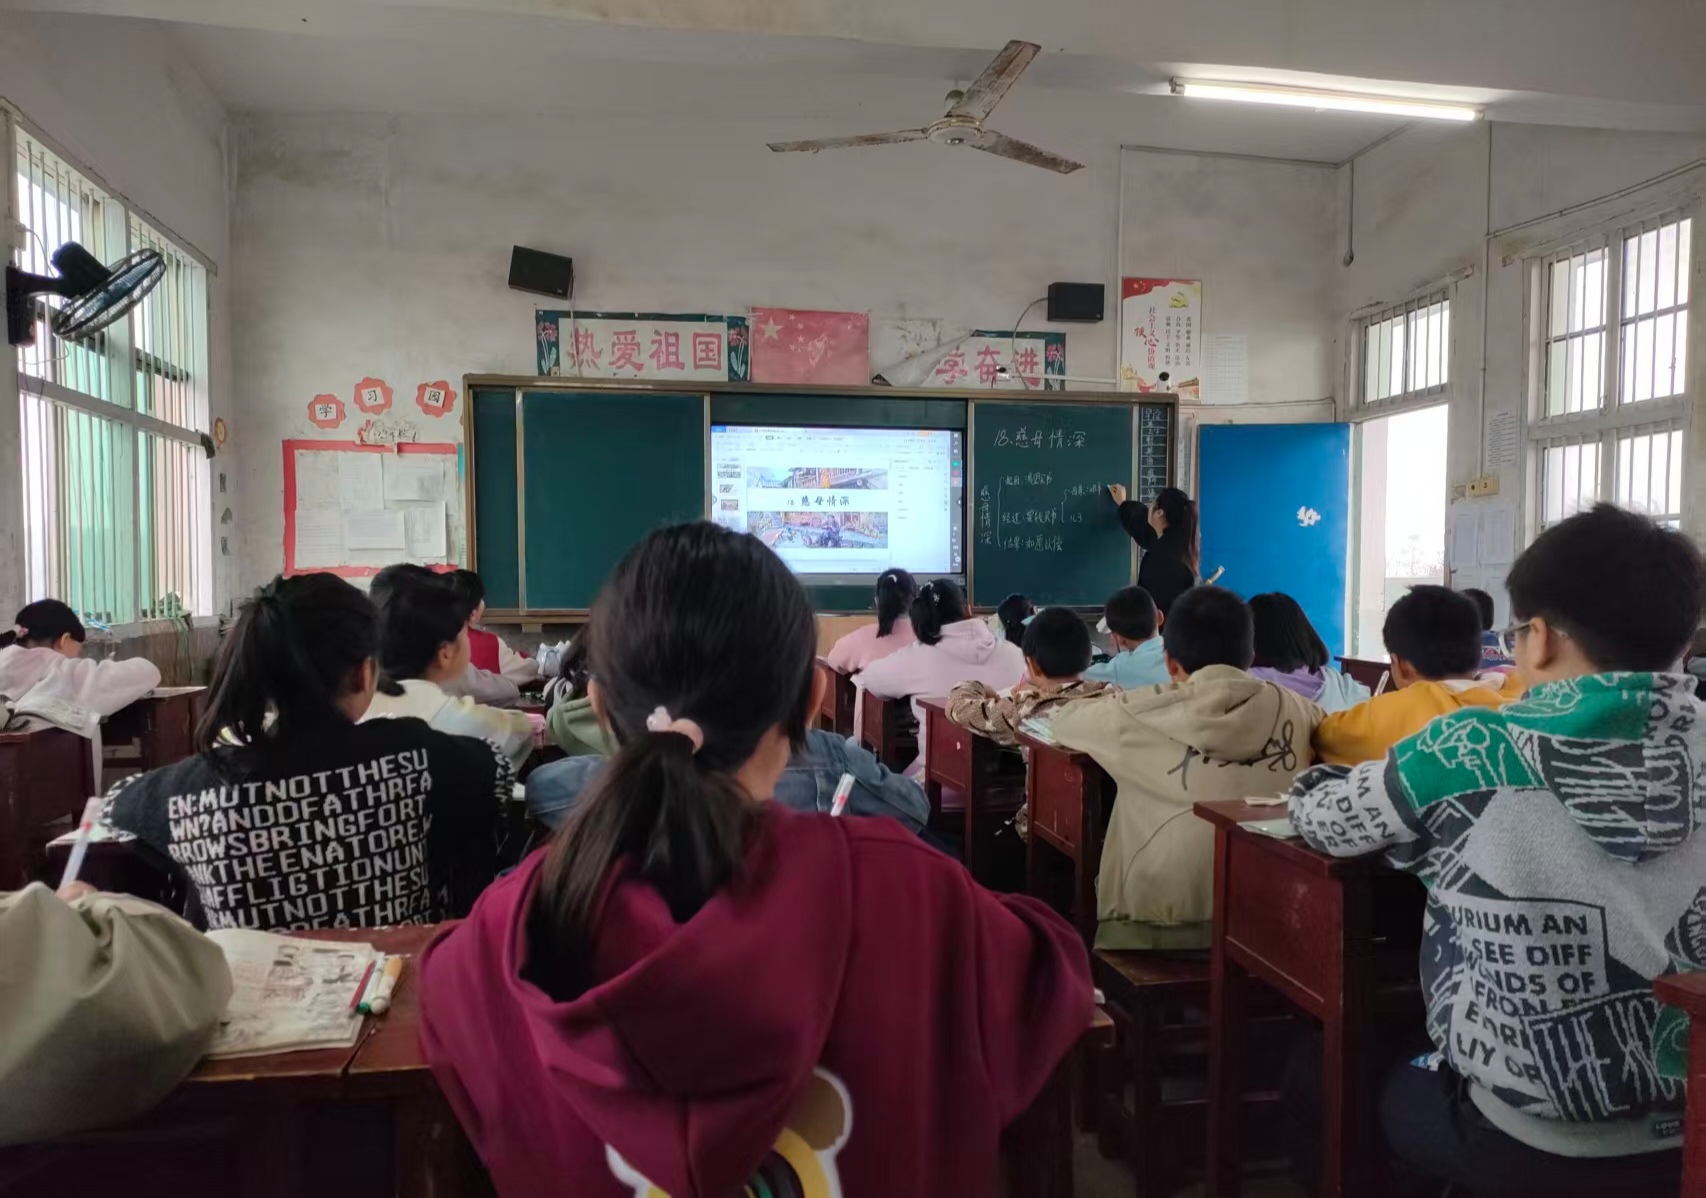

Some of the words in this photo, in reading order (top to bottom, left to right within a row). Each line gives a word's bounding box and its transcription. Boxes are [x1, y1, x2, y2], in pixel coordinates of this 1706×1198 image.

[567, 328, 723, 373] 热爱祖国
[1335, 796, 1377, 845] DIFF
[1542, 914, 1588, 935] AN
[1472, 938, 1515, 965] SEE
[1526, 944, 1592, 966] DIFF
[1557, 971, 1595, 995] OF
